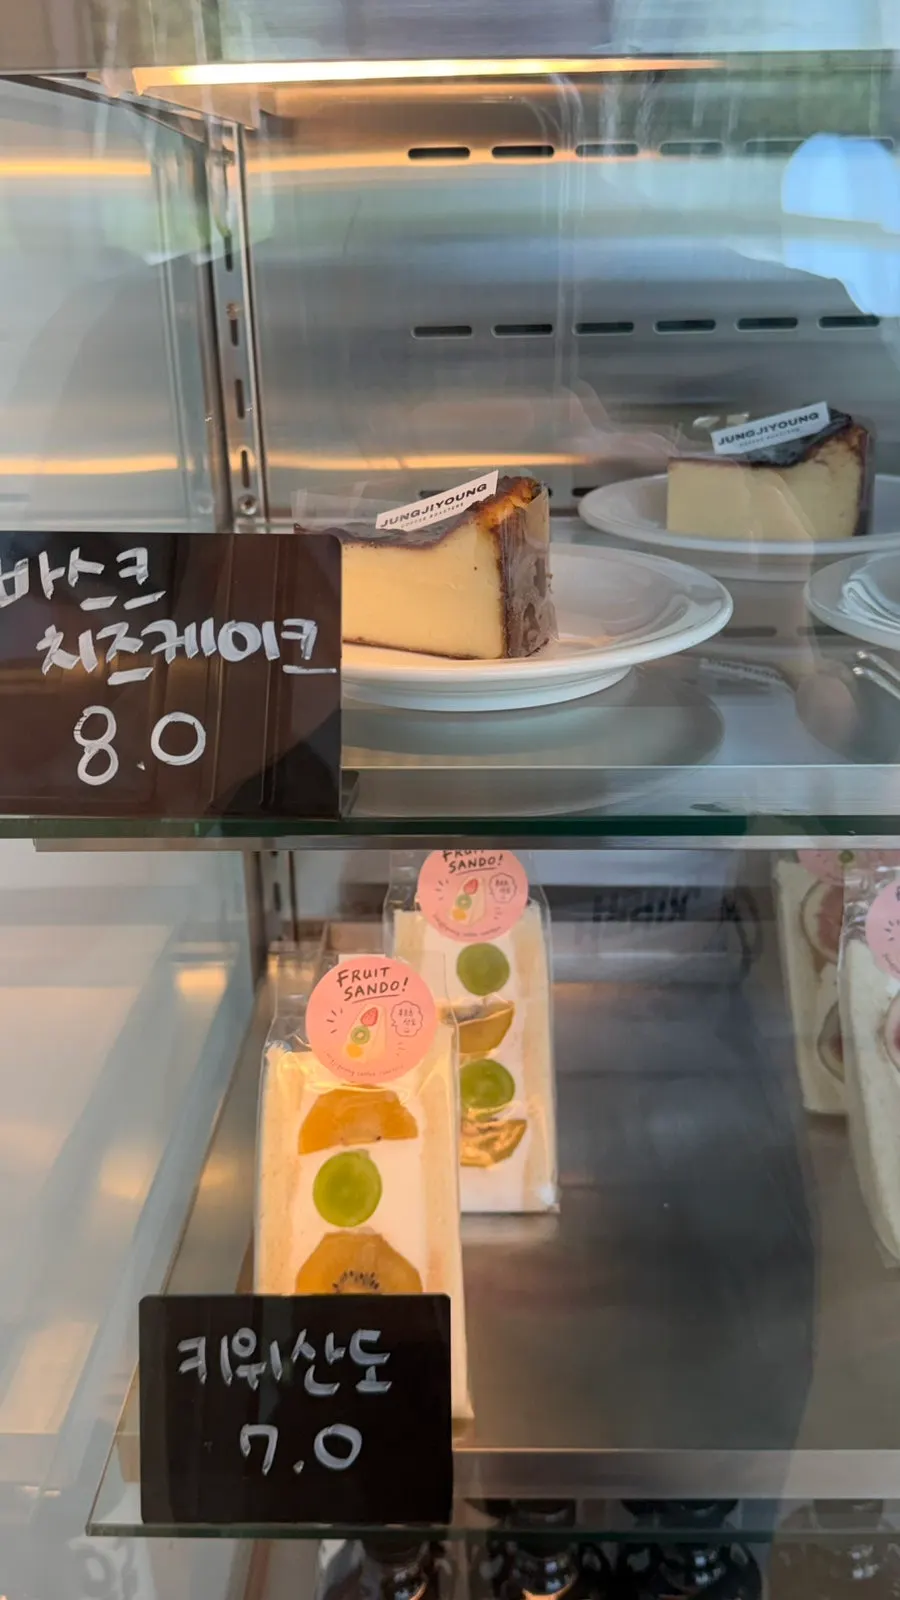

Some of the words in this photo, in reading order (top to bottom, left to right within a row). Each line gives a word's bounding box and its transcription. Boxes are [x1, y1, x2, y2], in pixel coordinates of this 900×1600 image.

[718, 412, 820, 446] JUNGJIYOUNG
[381, 483, 487, 527] JUNGJIYOUNG
[0, 547, 167, 610] 바스크
[36, 617, 337, 686] 치즈케이크
[73, 705, 206, 786] 8.0
[448, 853, 504, 874] SANDO!
[336, 966, 391, 988] FRUIT
[344, 977, 409, 1002] SANDO!
[177, 1328, 392, 1396] 키위산도
[239, 1423, 363, 1477] 7.0
